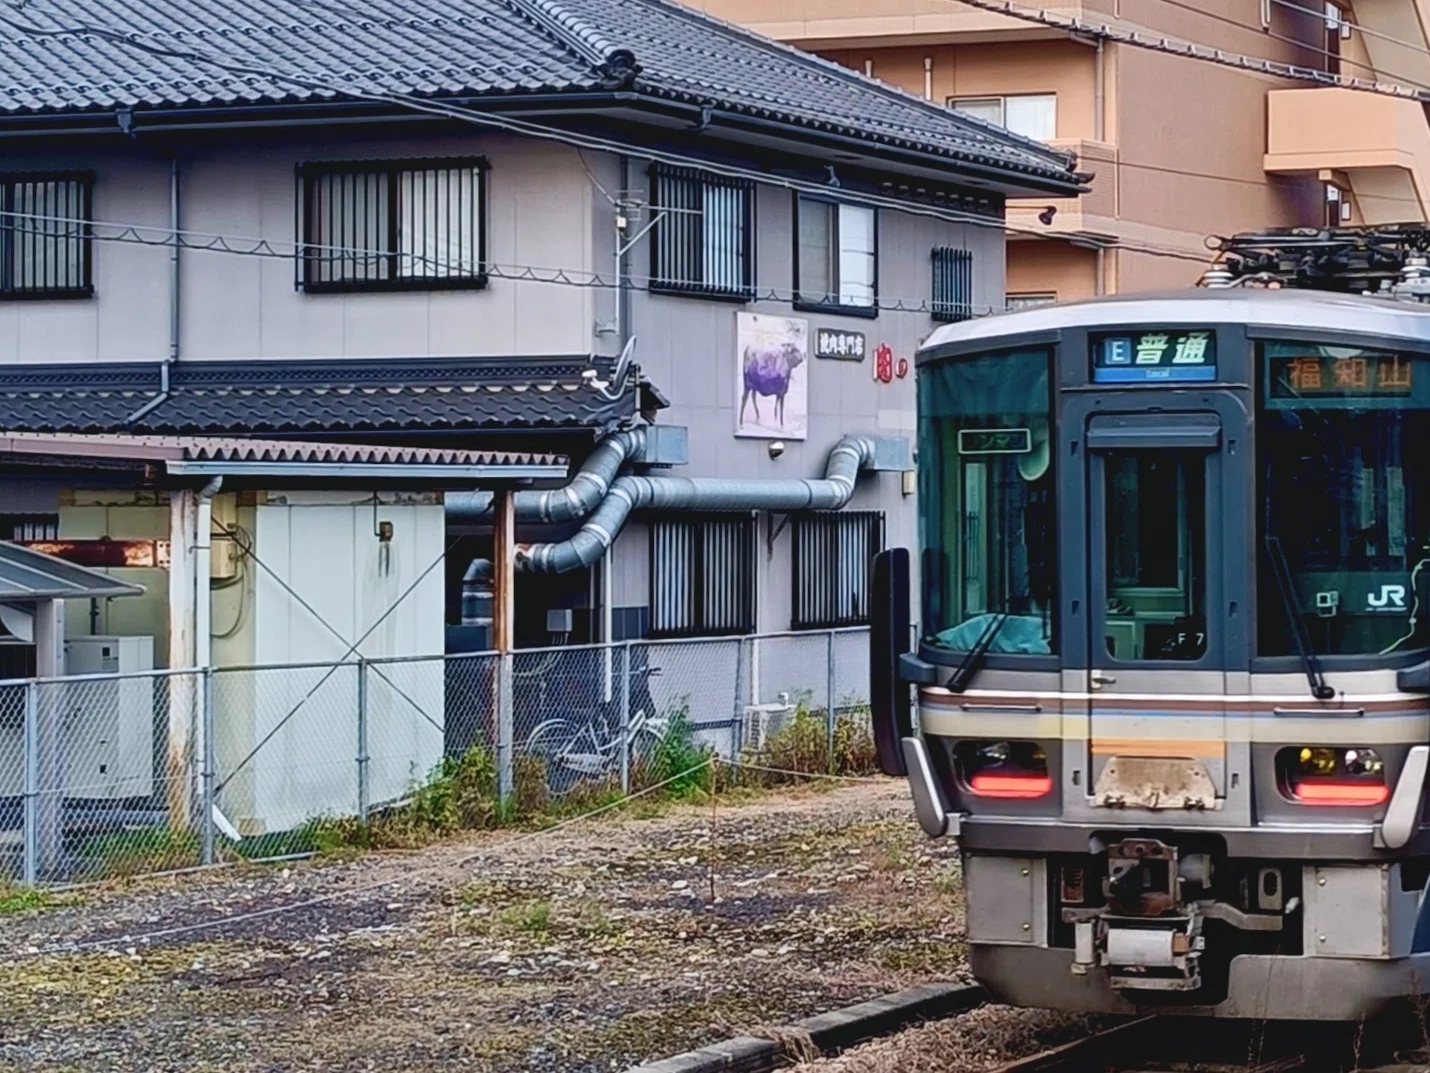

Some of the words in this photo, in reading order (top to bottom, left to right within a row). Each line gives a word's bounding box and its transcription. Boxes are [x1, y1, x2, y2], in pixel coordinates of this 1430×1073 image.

[1112, 341, 1125, 361] E
[1135, 331, 1210, 364] 普通
[1286, 355, 1412, 388] 福知山
[1367, 584, 1405, 607] JR
